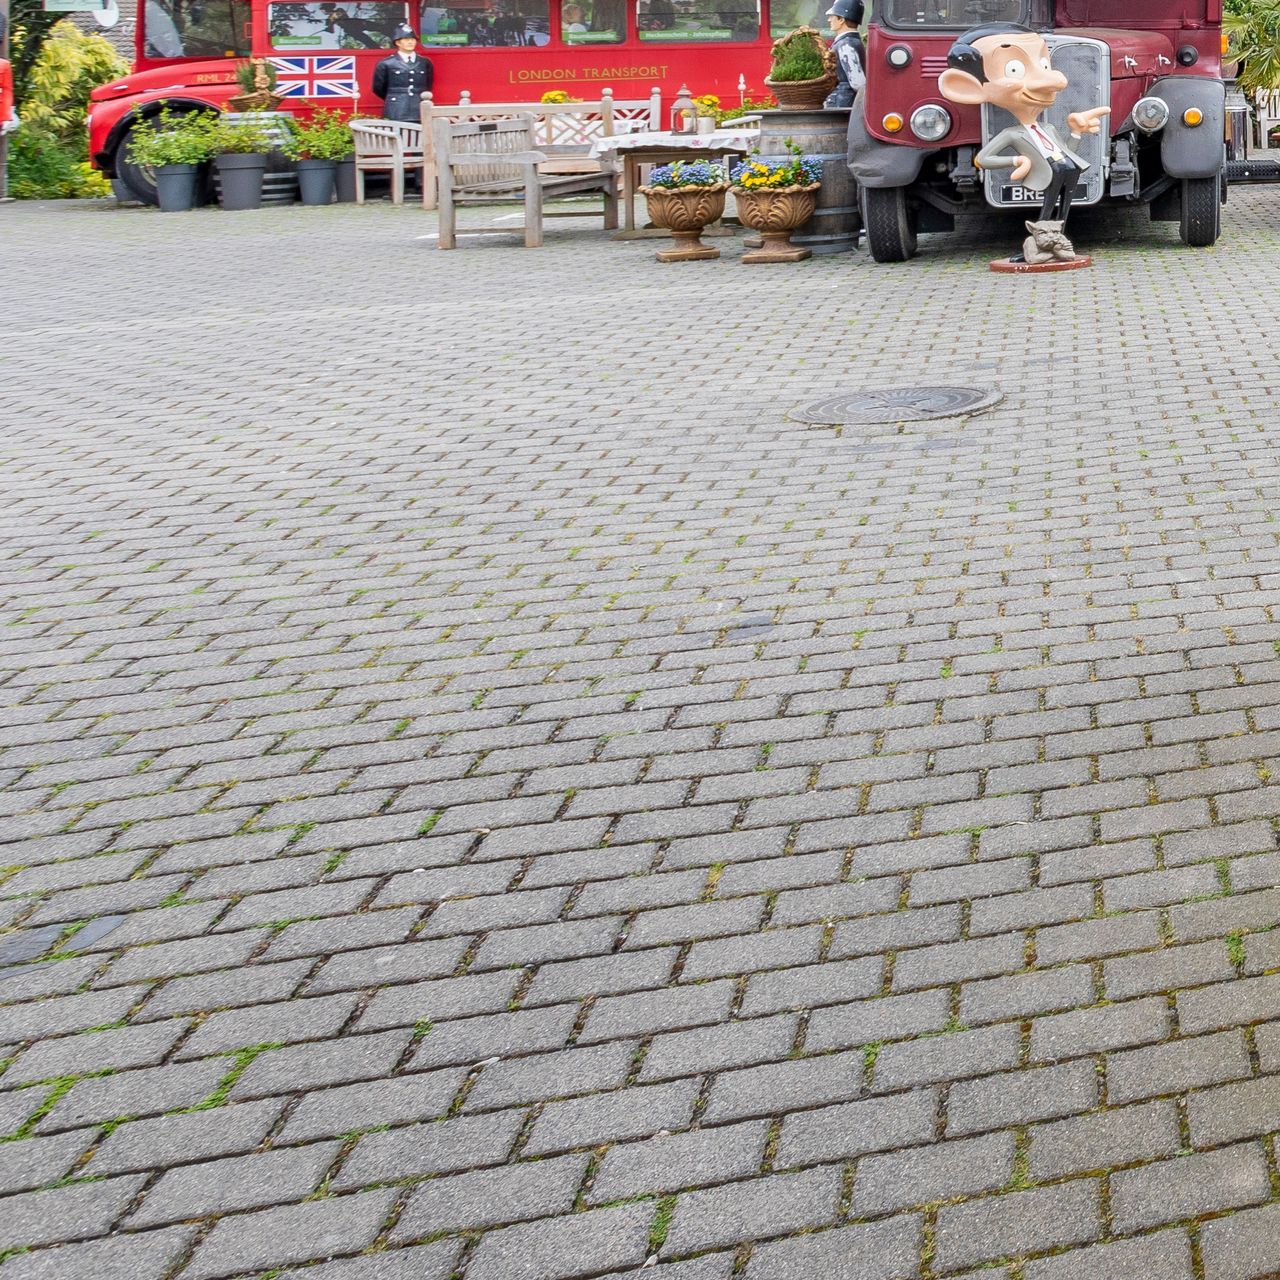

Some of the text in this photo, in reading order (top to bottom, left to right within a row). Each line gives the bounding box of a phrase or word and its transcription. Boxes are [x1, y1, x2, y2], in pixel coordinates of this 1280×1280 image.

[196, 74, 219, 83] RML
[509, 65, 668, 83] LONDON TRANSPORT
